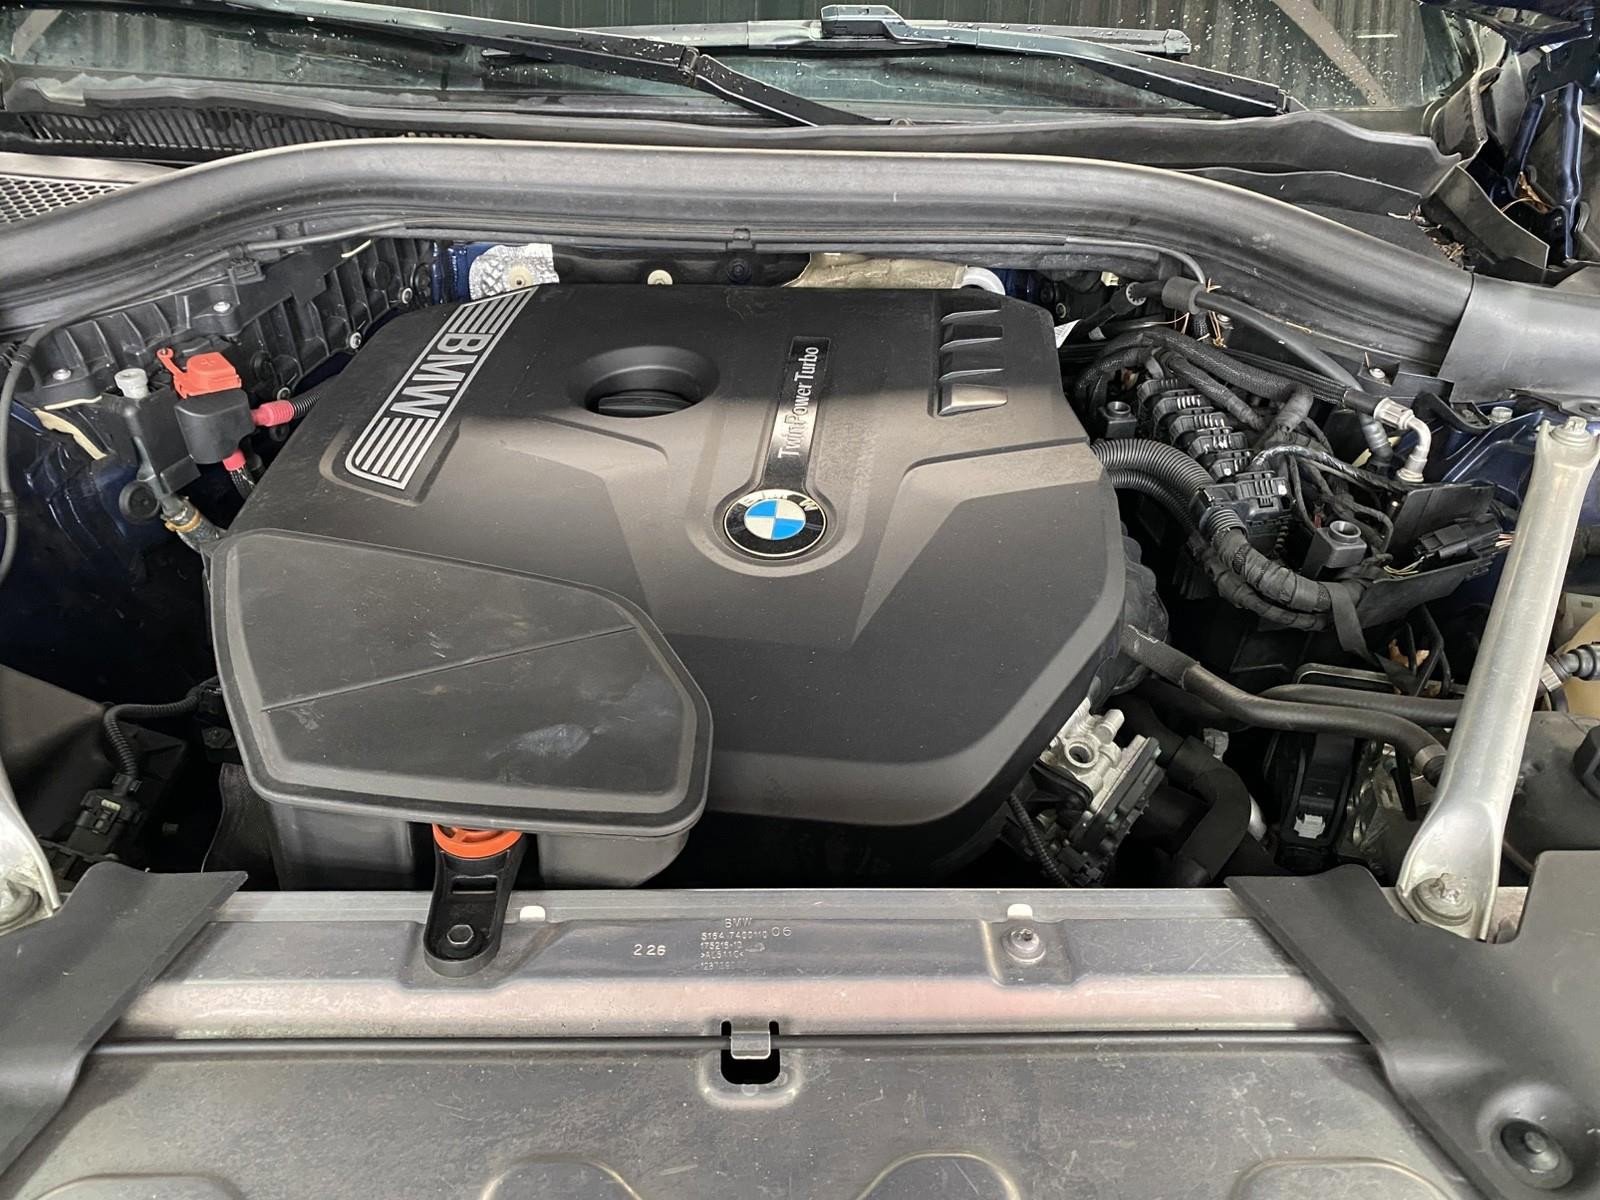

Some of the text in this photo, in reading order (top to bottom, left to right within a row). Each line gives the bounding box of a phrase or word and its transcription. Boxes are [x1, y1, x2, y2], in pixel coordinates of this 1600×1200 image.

[390, 333, 494, 419] BMW
[778, 346, 819, 459] TwinPower Turbo
